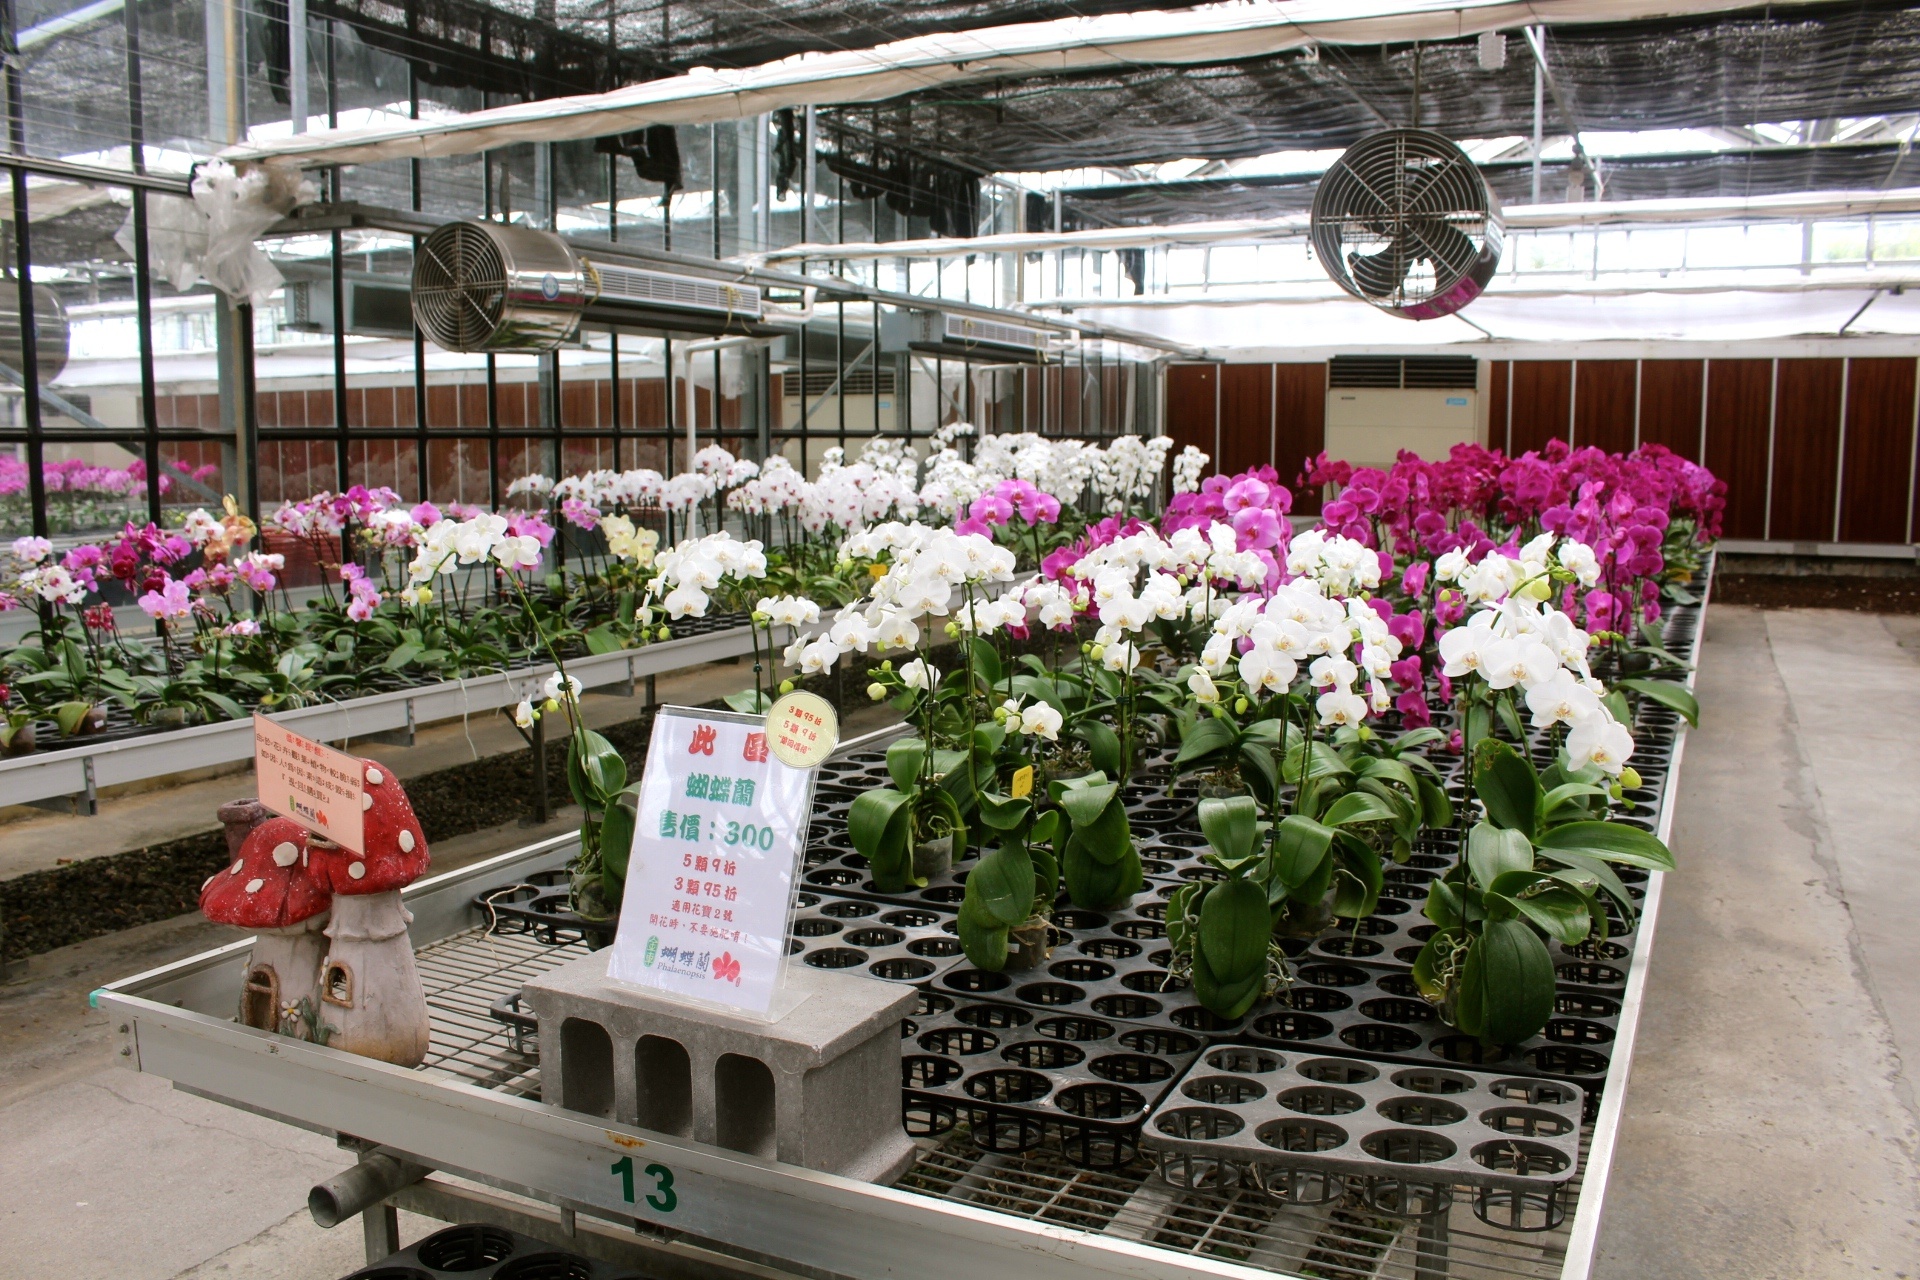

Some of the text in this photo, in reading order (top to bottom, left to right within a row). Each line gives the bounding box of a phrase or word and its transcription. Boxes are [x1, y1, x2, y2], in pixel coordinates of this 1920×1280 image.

[685, 772, 756, 806] 蝴蝶蘭
[659, 809, 774, 851] 售價：300
[683, 854, 736, 876] 5顆9折
[674, 876, 737, 901] 3顆95折
[671, 900, 733, 922] 適用花寶2號
[657, 962, 706, 979] Phalaenopsis
[660, 946, 711, 972] 蝴蝶蘭
[611, 1156, 677, 1212] 13
